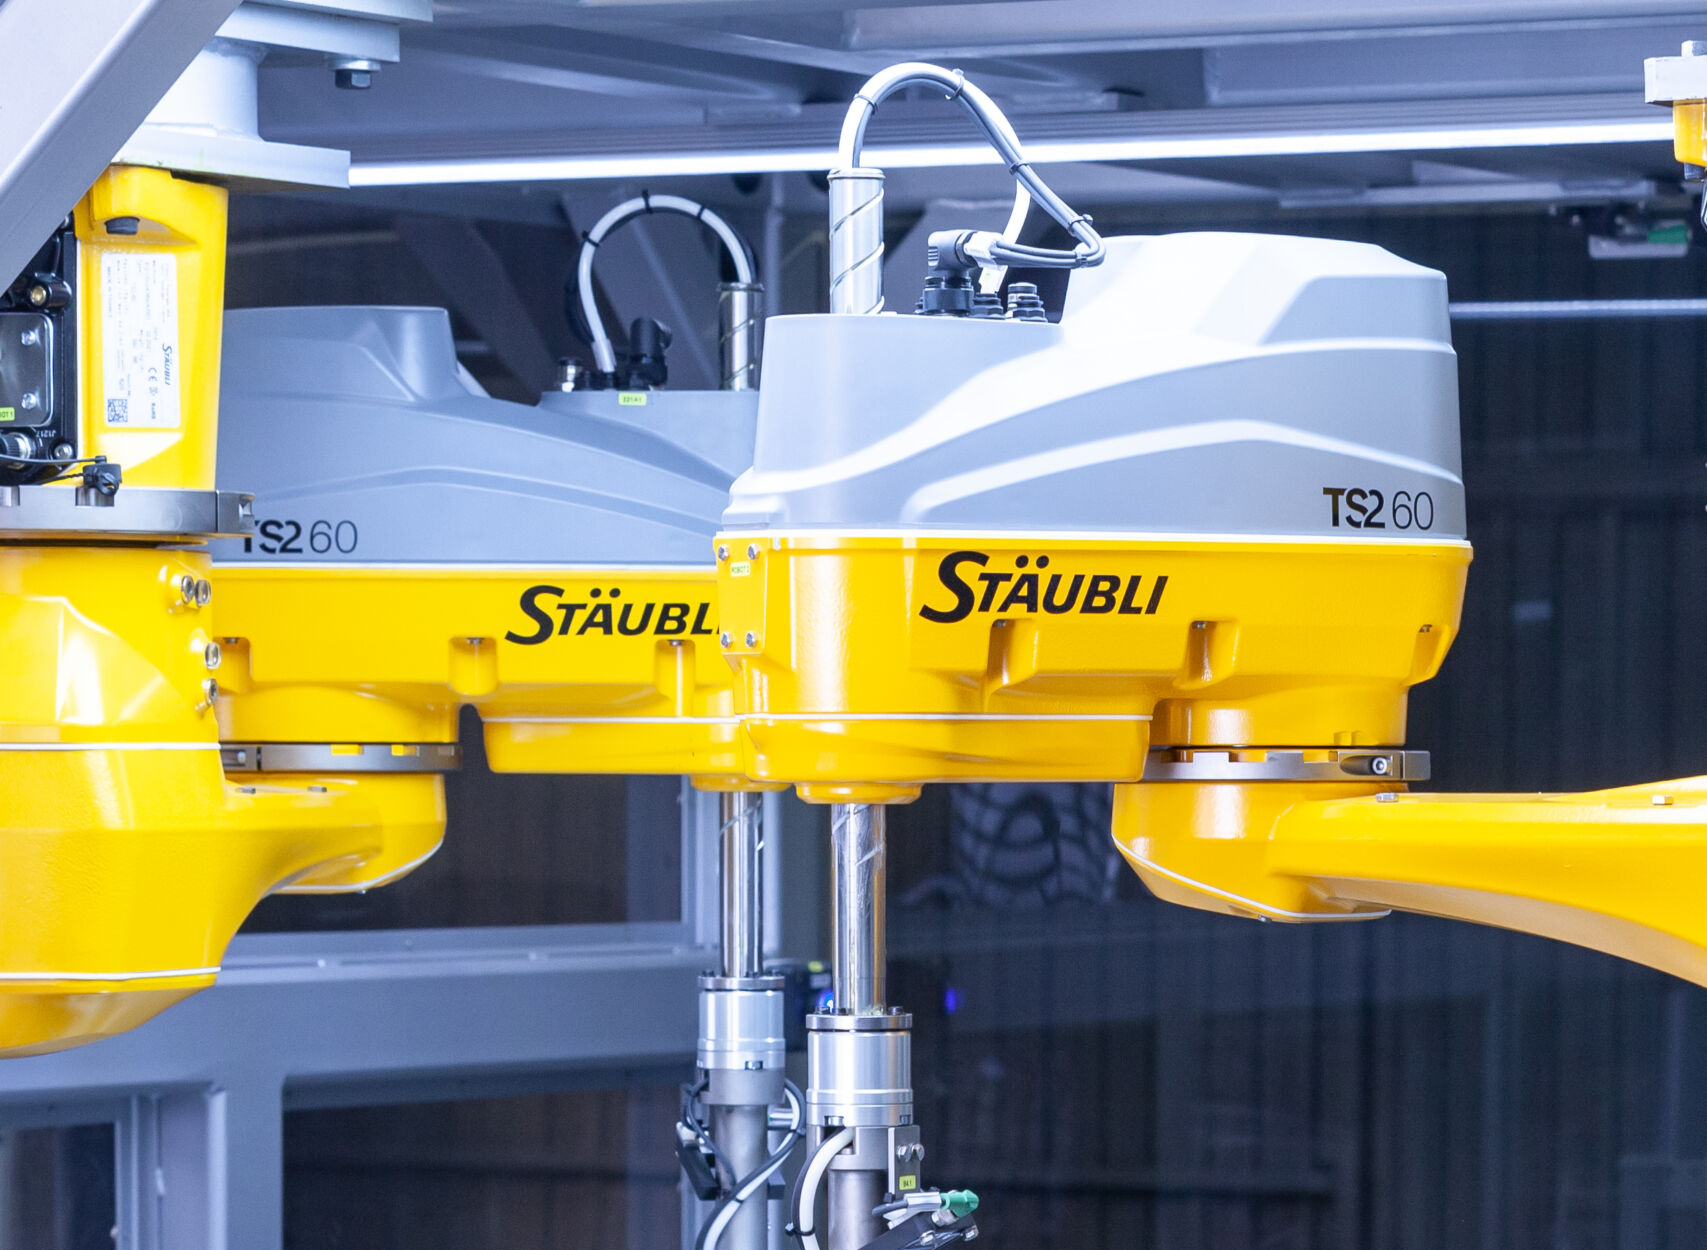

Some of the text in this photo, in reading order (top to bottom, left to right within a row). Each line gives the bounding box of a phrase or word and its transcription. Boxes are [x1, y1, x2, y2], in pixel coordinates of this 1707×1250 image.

[1323, 487, 1435, 530] TS2 60
[309, 520, 358, 554] 60
[919, 551, 1168, 623] STÄUBLI
[506, 586, 719, 645] STÄUBL
